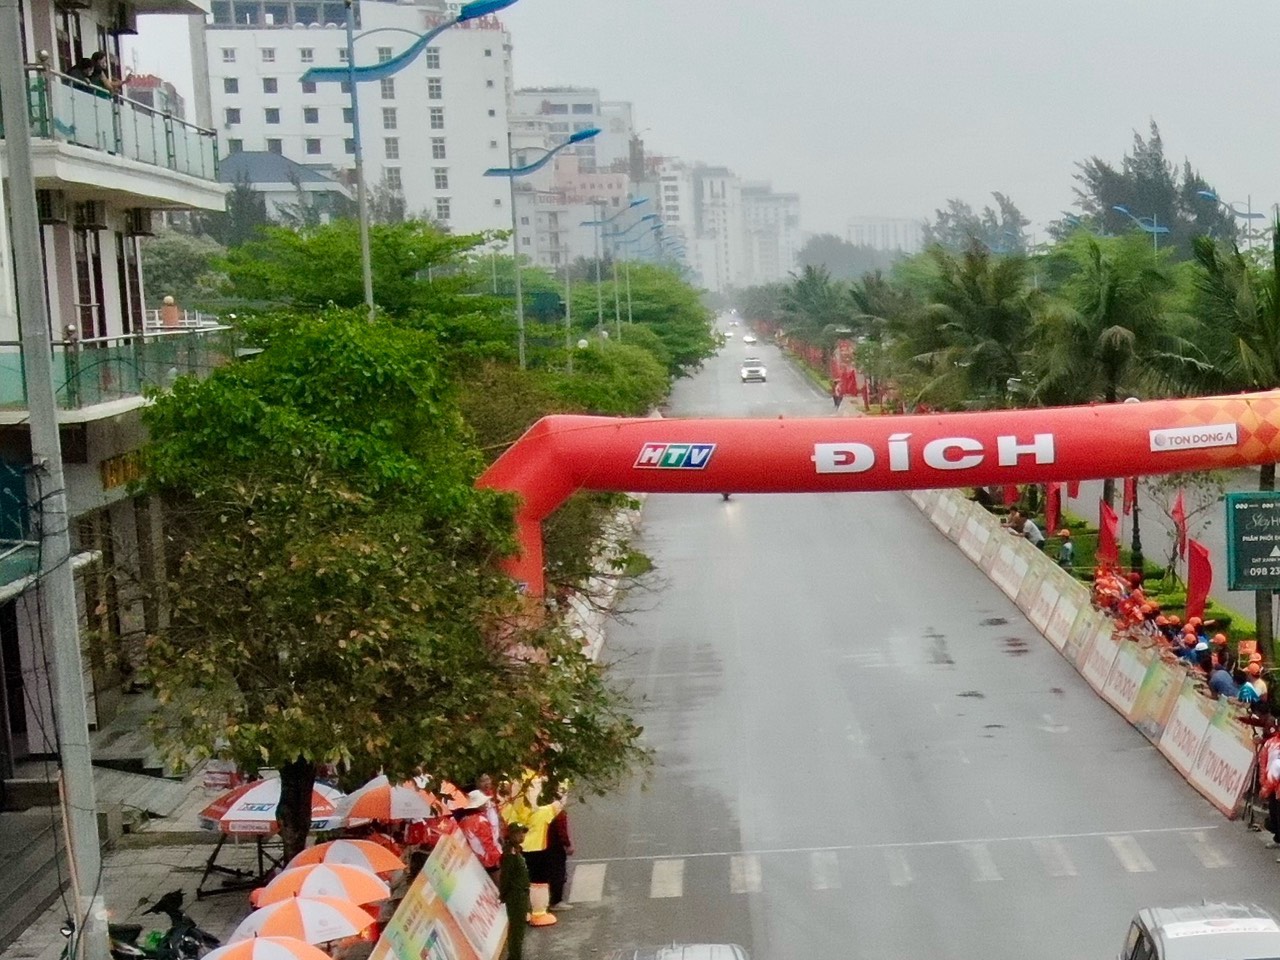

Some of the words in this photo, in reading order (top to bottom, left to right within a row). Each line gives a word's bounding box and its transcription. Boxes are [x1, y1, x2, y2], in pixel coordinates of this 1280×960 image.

[1168, 435, 1192, 446] TON
[1193, 432, 1224, 443] DONG
[1226, 432, 1234, 441] A
[636, 443, 714, 468] HTV
[811, 432, 1055, 474] ĐÍCH
[1250, 567, 1268, 576] 098
